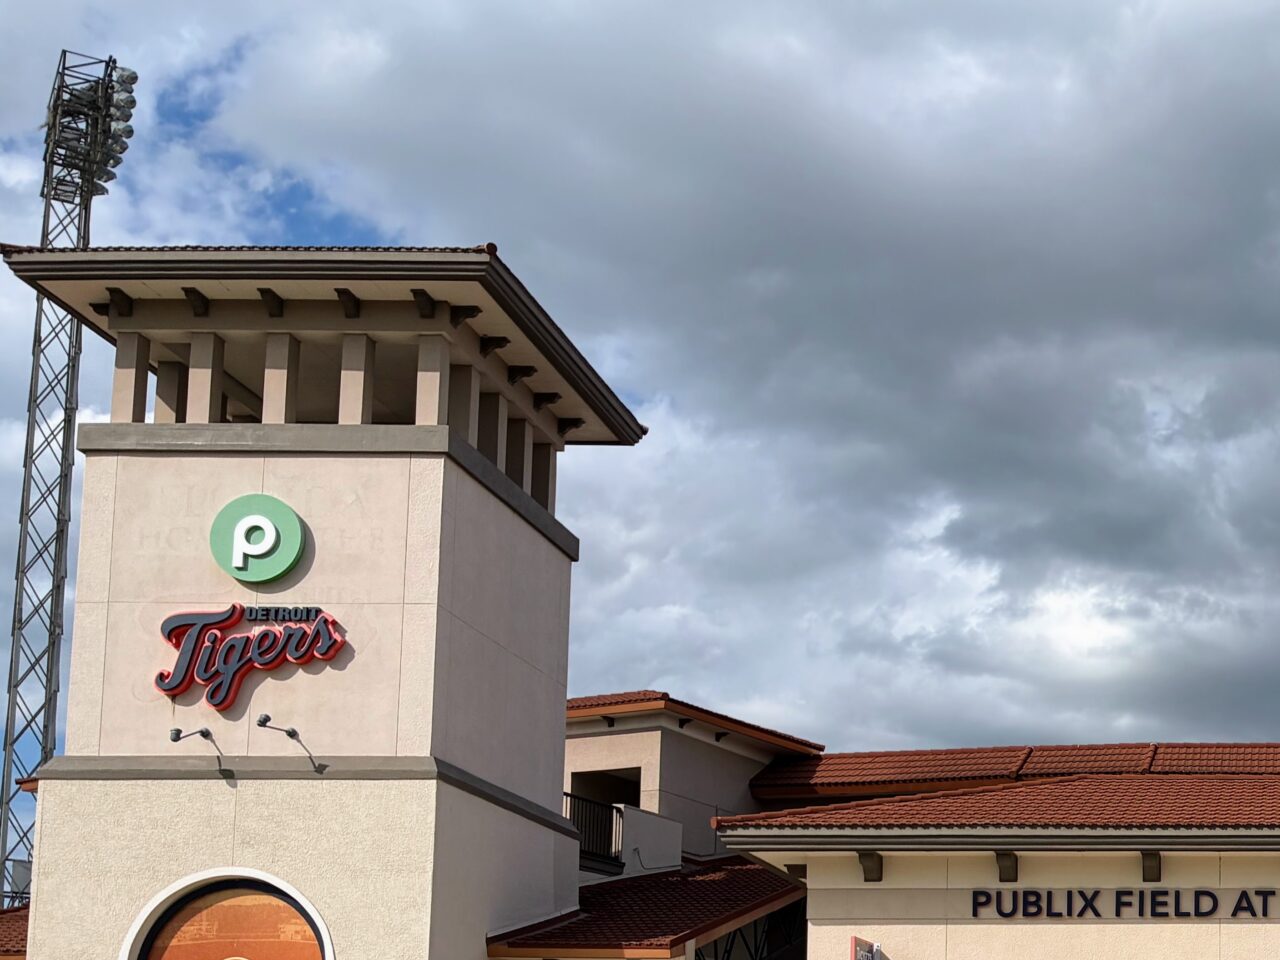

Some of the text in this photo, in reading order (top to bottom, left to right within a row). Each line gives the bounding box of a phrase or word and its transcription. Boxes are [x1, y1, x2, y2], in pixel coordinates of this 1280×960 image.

[244, 605, 322, 622] DETROIT
[155, 602, 346, 712] Tigers
[971, 889, 1102, 918] PUBLIX
[1114, 889, 1220, 918] FIELD
[1229, 889, 1277, 918] AT
